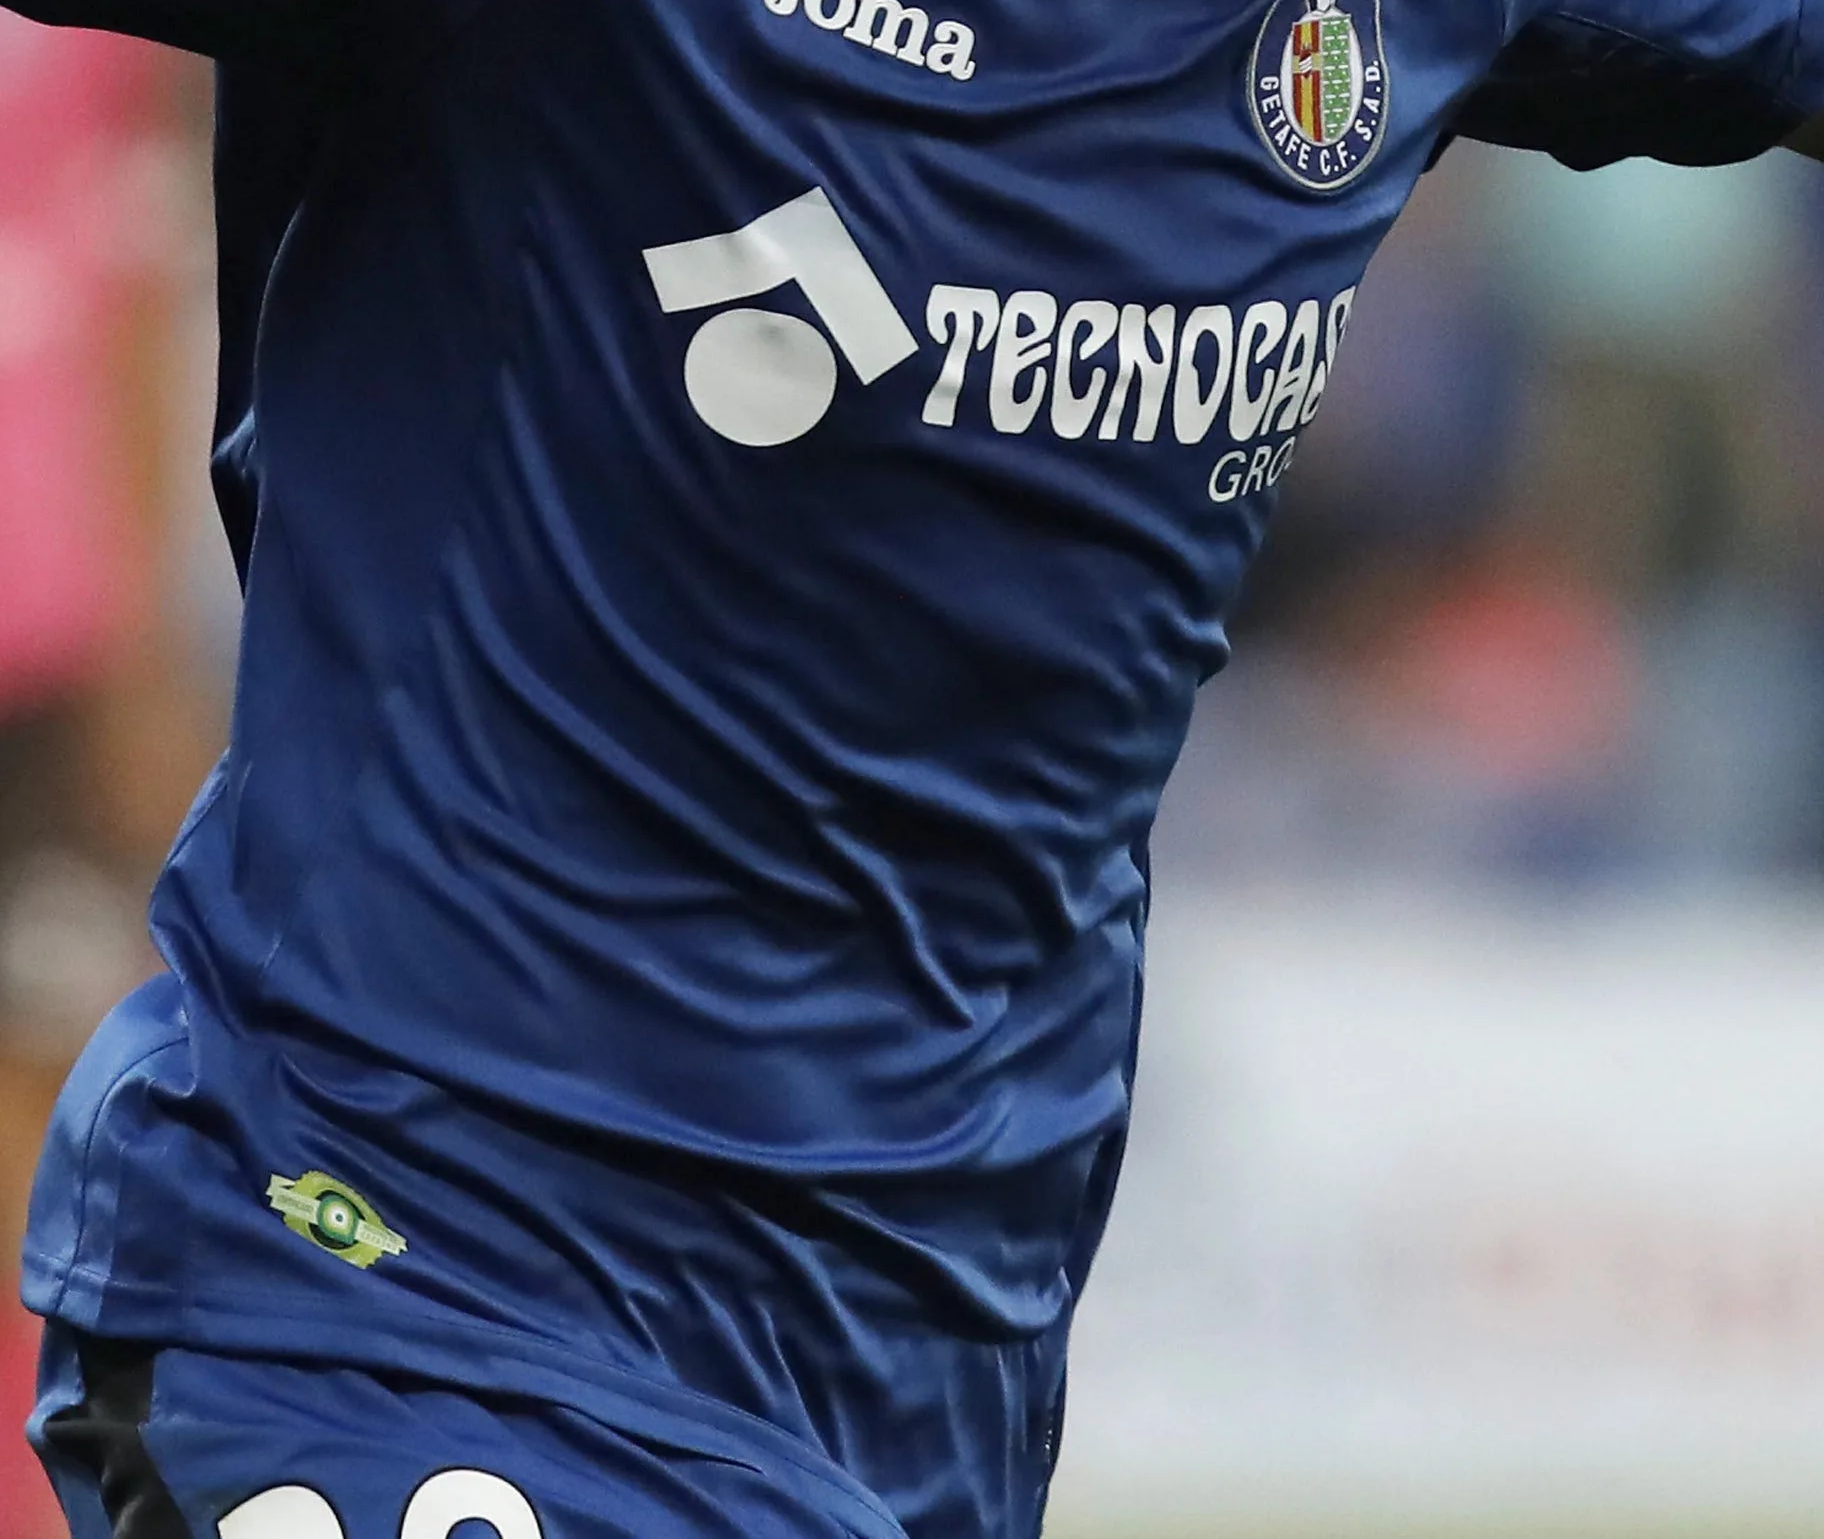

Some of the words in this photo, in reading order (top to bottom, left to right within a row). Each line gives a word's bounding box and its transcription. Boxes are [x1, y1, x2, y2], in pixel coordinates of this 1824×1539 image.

[1260, 76, 1312, 170] GETAFE
[1319, 141, 1357, 176] C.F.
[1355, 60, 1382, 142] S.A.D.
